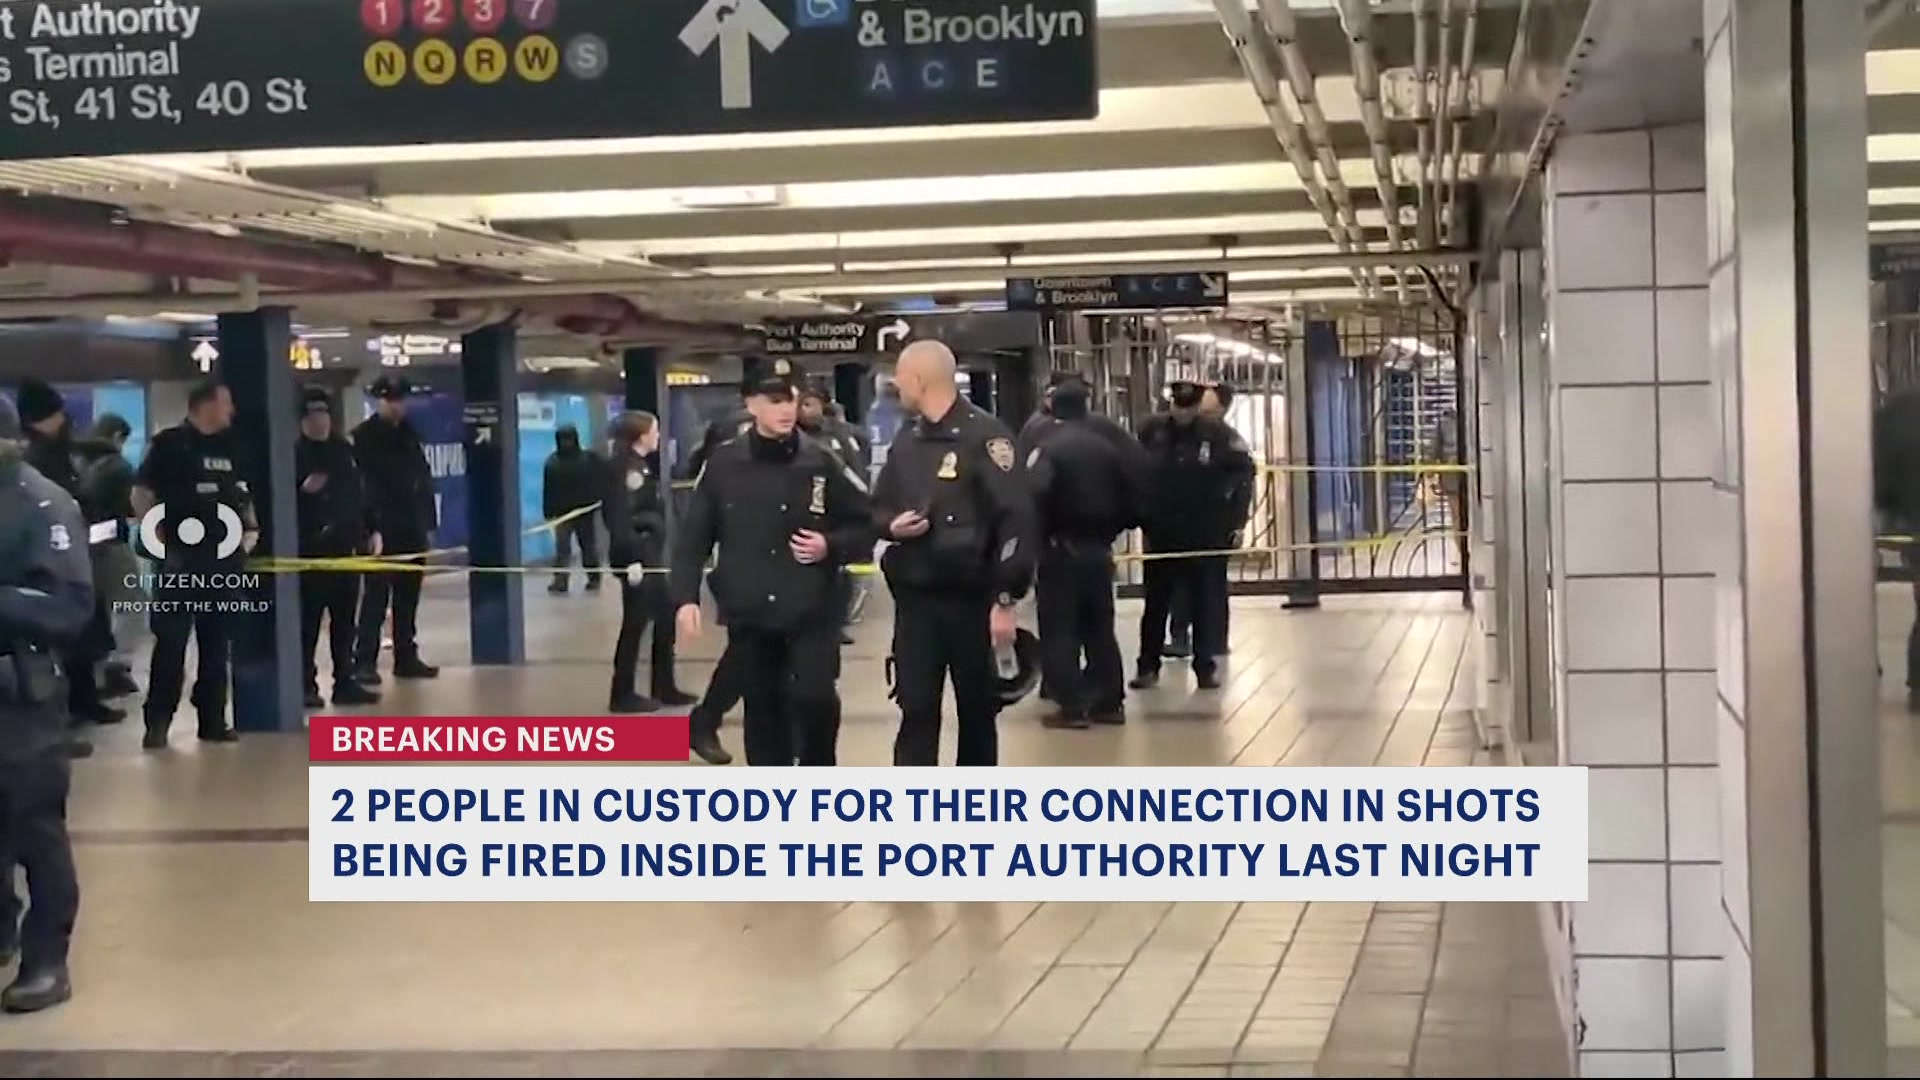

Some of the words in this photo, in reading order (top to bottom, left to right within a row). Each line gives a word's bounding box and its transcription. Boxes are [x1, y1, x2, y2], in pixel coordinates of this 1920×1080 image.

[30, 0, 201, 39] Authority
[375, 1, 388, 26] 1
[422, 0, 443, 24] 2
[474, 0, 493, 22] 3
[527, 0, 545, 20] 7
[857, 9, 888, 48] &
[903, 3, 1085, 47] Brooklyn
[25, 41, 180, 80] Terminal
[375, 51, 395, 76] N
[423, 49, 445, 75] Q
[476, 48, 495, 73] R
[522, 46, 551, 71] W
[576, 42, 598, 70] S
[870, 61, 893, 91] A
[921, 60, 945, 88] C
[976, 58, 999, 88] E
[9, 89, 61, 129] St,
[74, 86, 117, 121] 41
[130, 83, 183, 125] St,
[195, 81, 251, 116] 40
[265, 77, 309, 115] St
[1051, 290, 1120, 306] Brooklyn
[798, 337, 858, 351] Terminal
[799, 322, 867, 338] Authority
